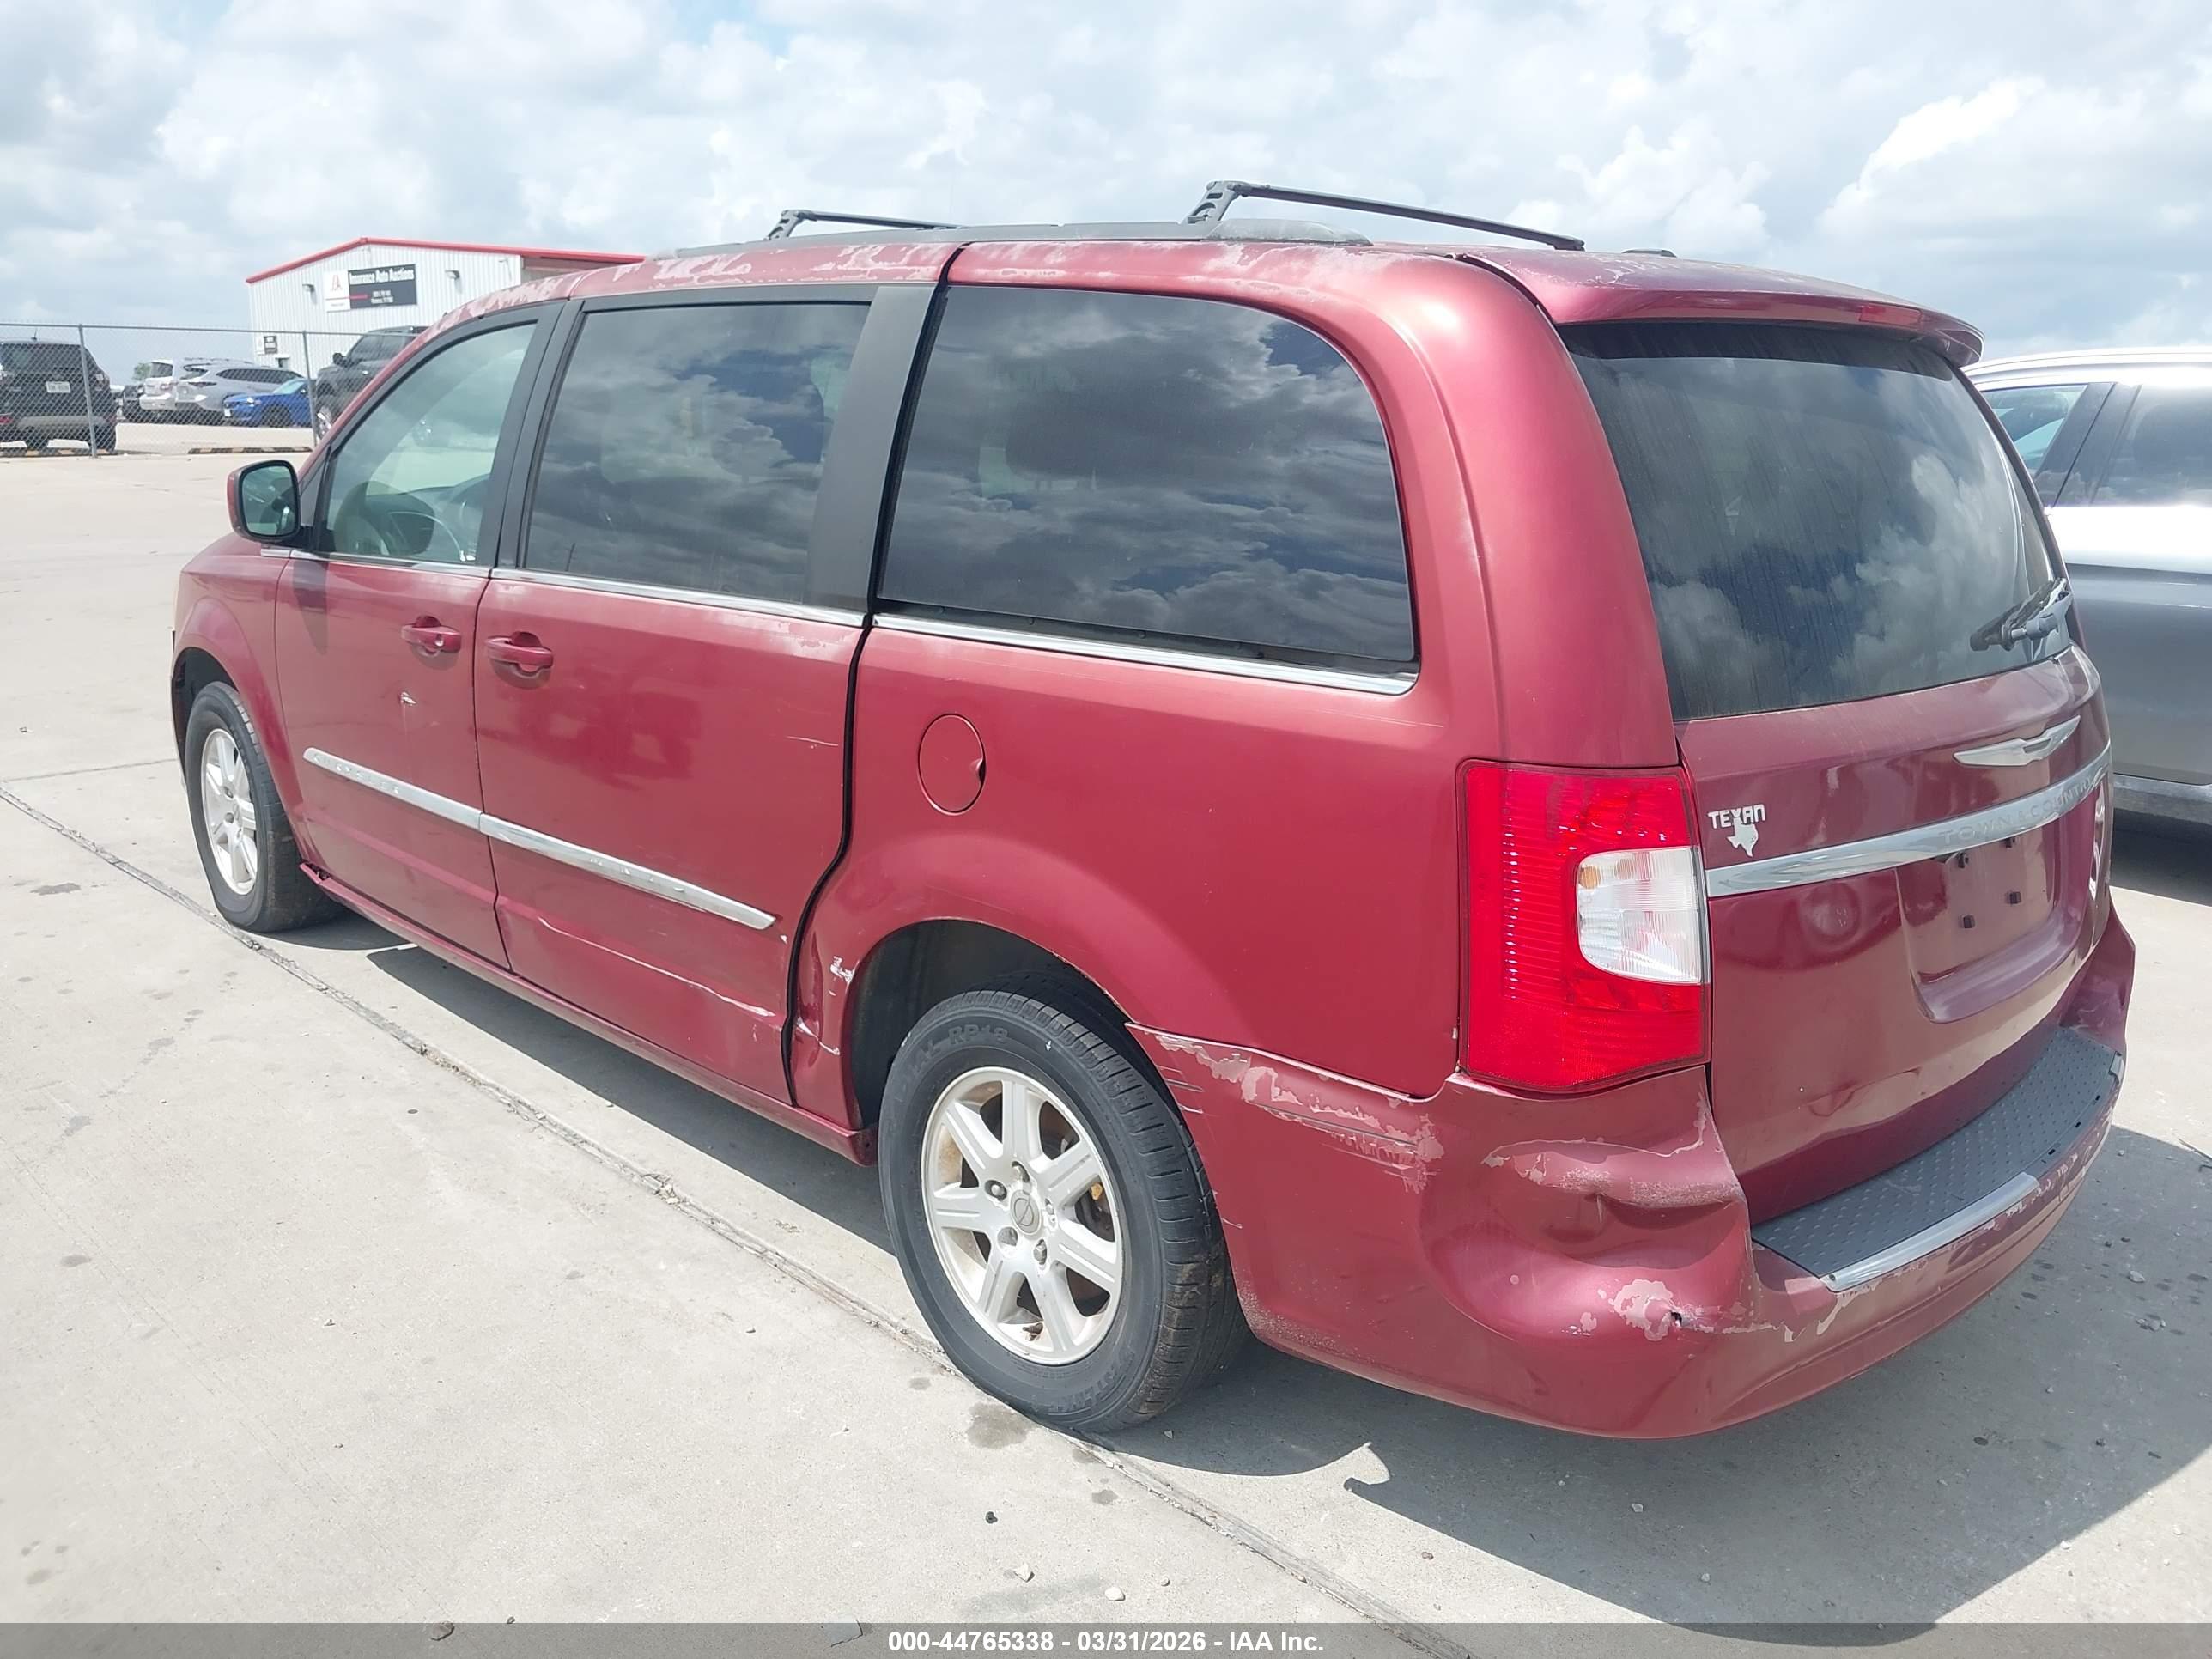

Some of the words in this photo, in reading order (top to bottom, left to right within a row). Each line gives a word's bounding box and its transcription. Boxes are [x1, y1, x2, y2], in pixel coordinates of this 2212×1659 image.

[375, 269, 389, 283] Auto
[389, 267, 414, 282] Auctions
[1707, 804, 1766, 830] TEXAN
[1938, 814, 2014, 846] TOWN
[2018, 810, 2029, 823] &
